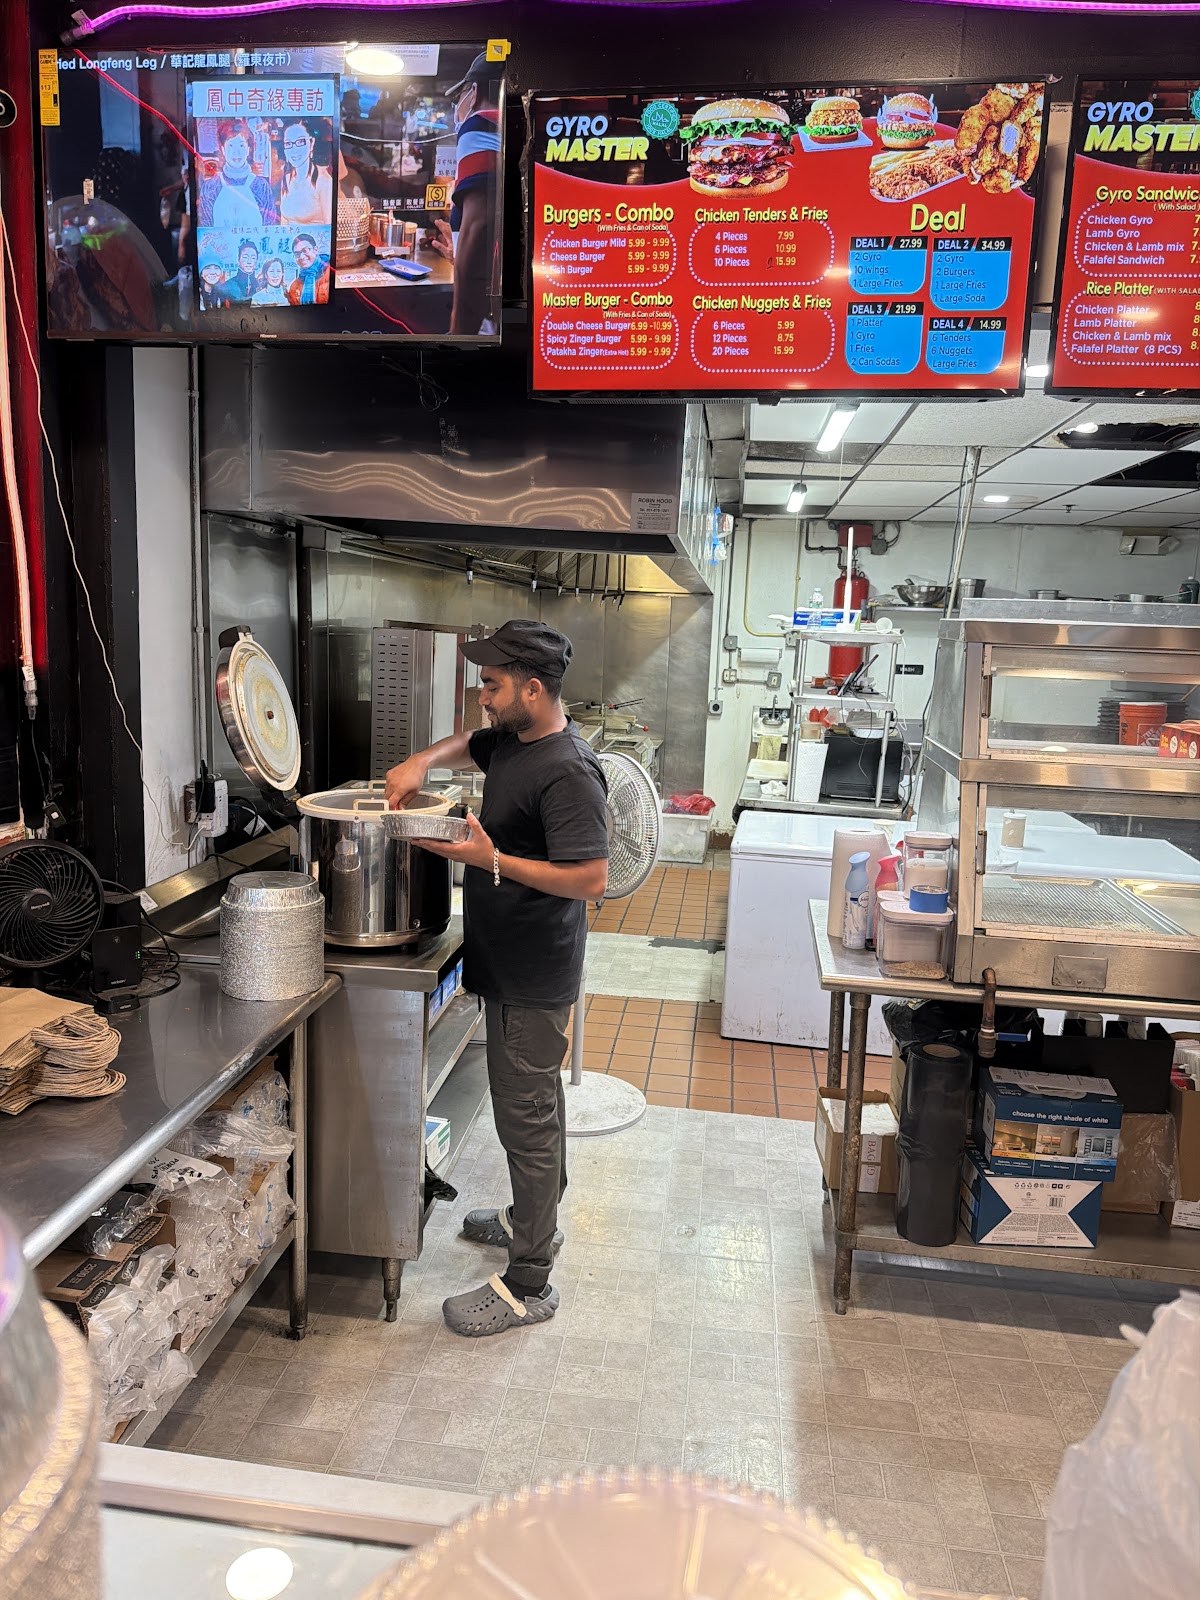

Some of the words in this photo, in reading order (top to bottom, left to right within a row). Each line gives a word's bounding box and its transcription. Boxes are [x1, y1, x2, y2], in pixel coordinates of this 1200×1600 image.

[57, 57, 75, 70] ied
[80, 57, 132, 71] Longfeng
[136, 57, 157, 71] Leg
[170, 54, 230, 68] 華記龍鳳腿
[234, 52, 291, 68] (羅東夜市)
[207, 88, 323, 112] 鳳中奇緣專訪
[1087, 101, 1154, 122] GYRO
[546, 116, 608, 137] GYRO
[545, 137, 649, 162] MASTER
[1096, 186, 1132, 204] Gyro
[1136, 186, 1200, 202] Sandwic
[544, 204, 601, 229] Burgers
[615, 202, 674, 223] Combo
[695, 208, 740, 223] Chicken
[742, 207, 787, 222] Tenders
[789, 206, 799, 222] &
[801, 206, 828, 221] Fries
[910, 204, 966, 232] Deal
[1087, 215, 1126, 225] Chicken
[1129, 216, 1153, 226] Gyro
[613, 224, 626, 232] Fries
[723, 232, 748, 240] Pieces
[778, 231, 794, 240] 7.99
[1086, 229, 1114, 238] Lamb
[1116, 229, 1140, 239] Gyro
[550, 238, 580, 248] Chicken
[582, 239, 608, 250] Burger
[610, 238, 626, 247] Mild
[628, 239, 645, 248] 5.99
[653, 238, 670, 247] 9.99
[856, 239, 879, 248] DEAL
[900, 238, 922, 248] 27.99
[938, 240, 961, 250] DEAL
[982, 240, 1005, 250] 34.99
[1084, 242, 1123, 251] Chicken
[1126, 242, 1133, 251] &
[1136, 242, 1163, 251] Lamb
[1166, 242, 1184, 251] mix
[722, 245, 747, 254] Pieces
[776, 244, 796, 253] 10.99
[550, 252, 577, 261] Cheese
[580, 252, 605, 262] Burger
[628, 252, 645, 260] 5.99
[652, 251, 670, 260] 9.99
[714, 258, 723, 266] 10
[725, 258, 750, 266] Pieces
[776, 257, 796, 266] 15.99
[862, 253, 881, 261] Gyro
[944, 255, 964, 263] Gyro
[1083, 255, 1116, 264] Falafel
[1117, 255, 1165, 265] Sandwich
[550, 265, 566, 274] Fish
[567, 265, 593, 276] Burger
[628, 265, 645, 274] 5.99
[652, 264, 669, 272] 9.99
[865, 266, 889, 275] wings
[944, 268, 975, 277] Burgers
[859, 279, 882, 289] Large
[883, 279, 903, 287] Fries
[941, 281, 963, 290] Large
[966, 281, 986, 289] Fries
[1086, 281, 1112, 295] Rice
[1114, 282, 1154, 295] Platter
[543, 292, 581, 307] Master
[584, 292, 620, 310] Burger
[631, 292, 673, 307] Combo
[693, 296, 738, 310] Chicken
[741, 295, 789, 313] Nuggets
[792, 295, 801, 309] &
[805, 294, 832, 309] Fries
[940, 294, 962, 304] Large
[965, 294, 986, 302] Soda
[852, 305, 874, 314] DEAL
[895, 304, 916, 314] 21.99
[1075, 305, 1114, 314] Chicken
[1116, 305, 1150, 314] Platter
[619, 311, 630, 319] Fries
[547, 321, 574, 330] Double
[576, 321, 603, 330] Cheese
[605, 321, 630, 332] Burger
[631, 322, 648, 330] 6.99
[720, 321, 745, 330] Pieces
[777, 321, 794, 329] 5.99
[857, 318, 883, 326] Platter
[933, 320, 956, 328] DEAL
[958, 320, 964, 328] 4
[980, 320, 1001, 329] 14.99
[1074, 318, 1101, 328] Lamb
[1104, 318, 1136, 328] Platter
[546, 334, 567, 344] Spicy
[570, 334, 594, 344] Zinger
[596, 334, 621, 344] Burger
[630, 335, 647, 343] 5.99
[655, 334, 671, 343] 9.99
[713, 334, 720, 343] 12
[723, 334, 747, 343] Pieces
[777, 333, 793, 342] 8.75
[856, 332, 875, 341] Gyro
[940, 333, 971, 342] Tenders
[1072, 331, 1111, 340] Chicken
[1114, 332, 1120, 340] &
[1123, 332, 1151, 341] Lamb
[1154, 332, 1171, 341] mix
[547, 347, 576, 356] Patakha
[630, 348, 646, 356] 5.99
[654, 348, 671, 356] 9.99
[712, 347, 722, 356] 20
[724, 347, 749, 356] Pieces
[774, 346, 794, 354] 15.99
[856, 344, 874, 352] Fries
[939, 346, 972, 356] Nuggets
[1071, 344, 1103, 353] Falafel
[1106, 344, 1138, 354] Platter
[1158, 345, 1182, 355] PCS)
[858, 358, 874, 366] Can
[876, 357, 900, 366] Sodas
[933, 360, 955, 369] Large
[958, 360, 977, 368] Fries
[1012, 1110, 1035, 1118] choose
